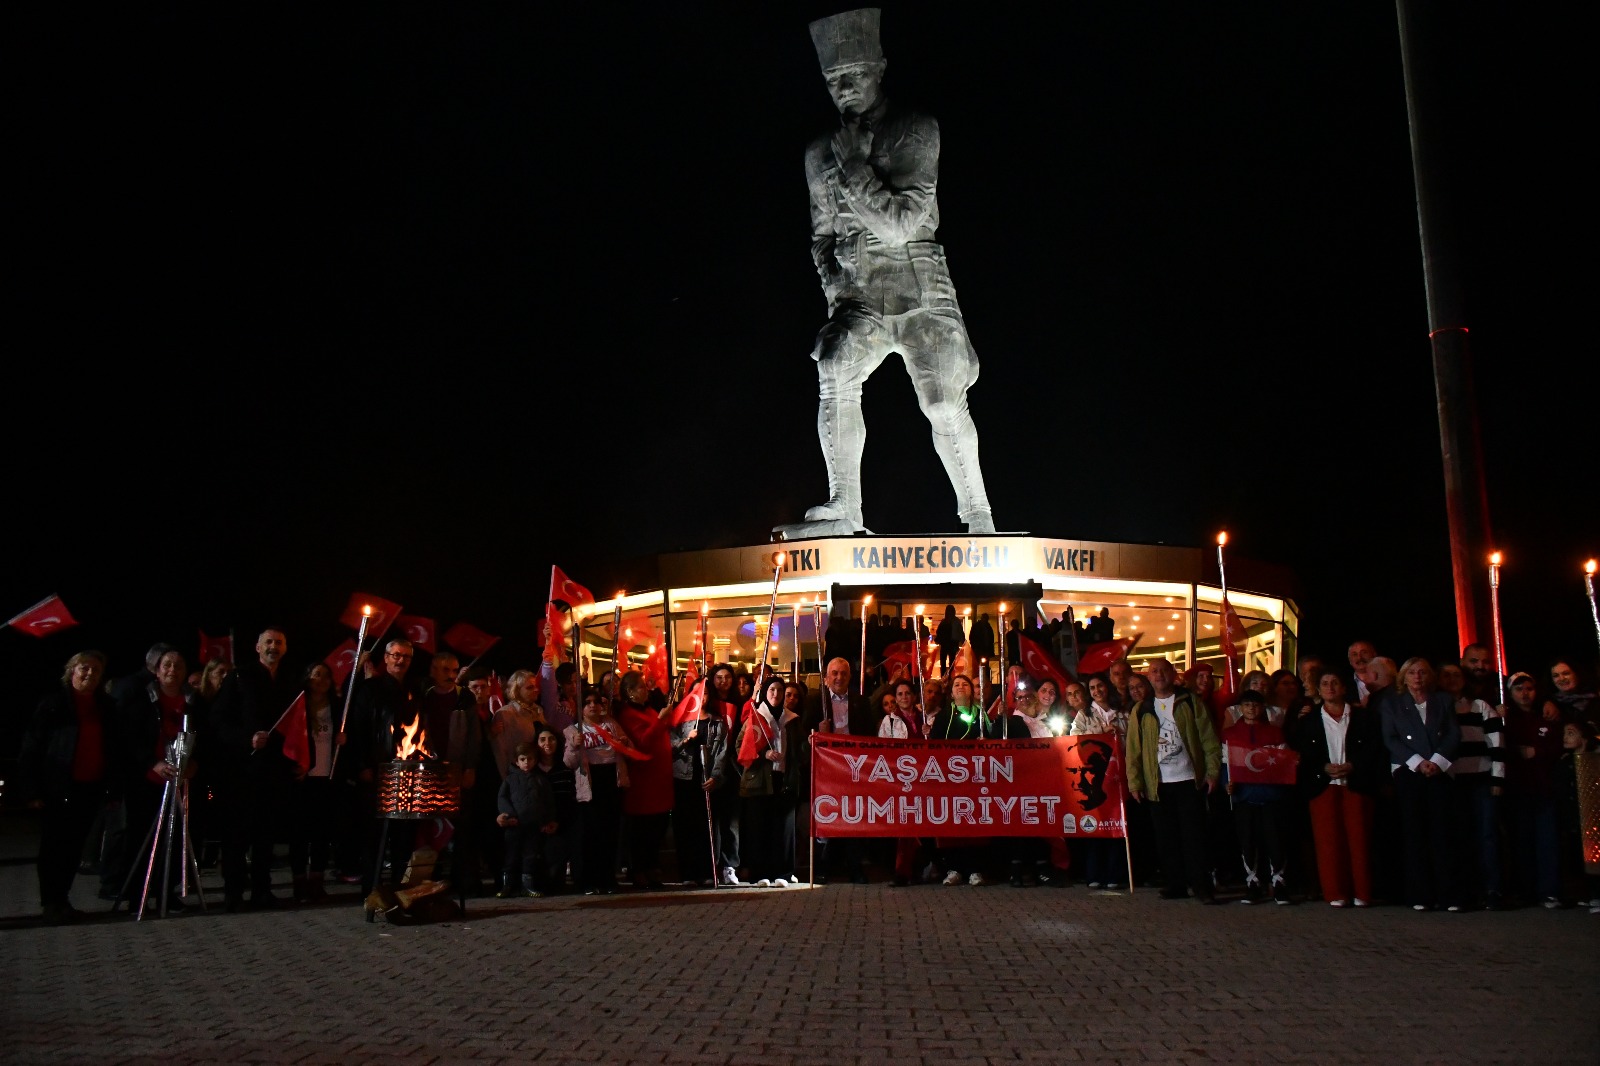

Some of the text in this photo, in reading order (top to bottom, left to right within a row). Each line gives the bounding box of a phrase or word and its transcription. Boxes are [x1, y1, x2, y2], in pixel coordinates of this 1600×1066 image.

[853, 540, 1009, 569] KAHVECİOĞLU
[1043, 547, 1095, 572] VAKFI
[843, 754, 1014, 792] YAŞASIN
[814, 786, 1061, 825] CUMHURİYET
